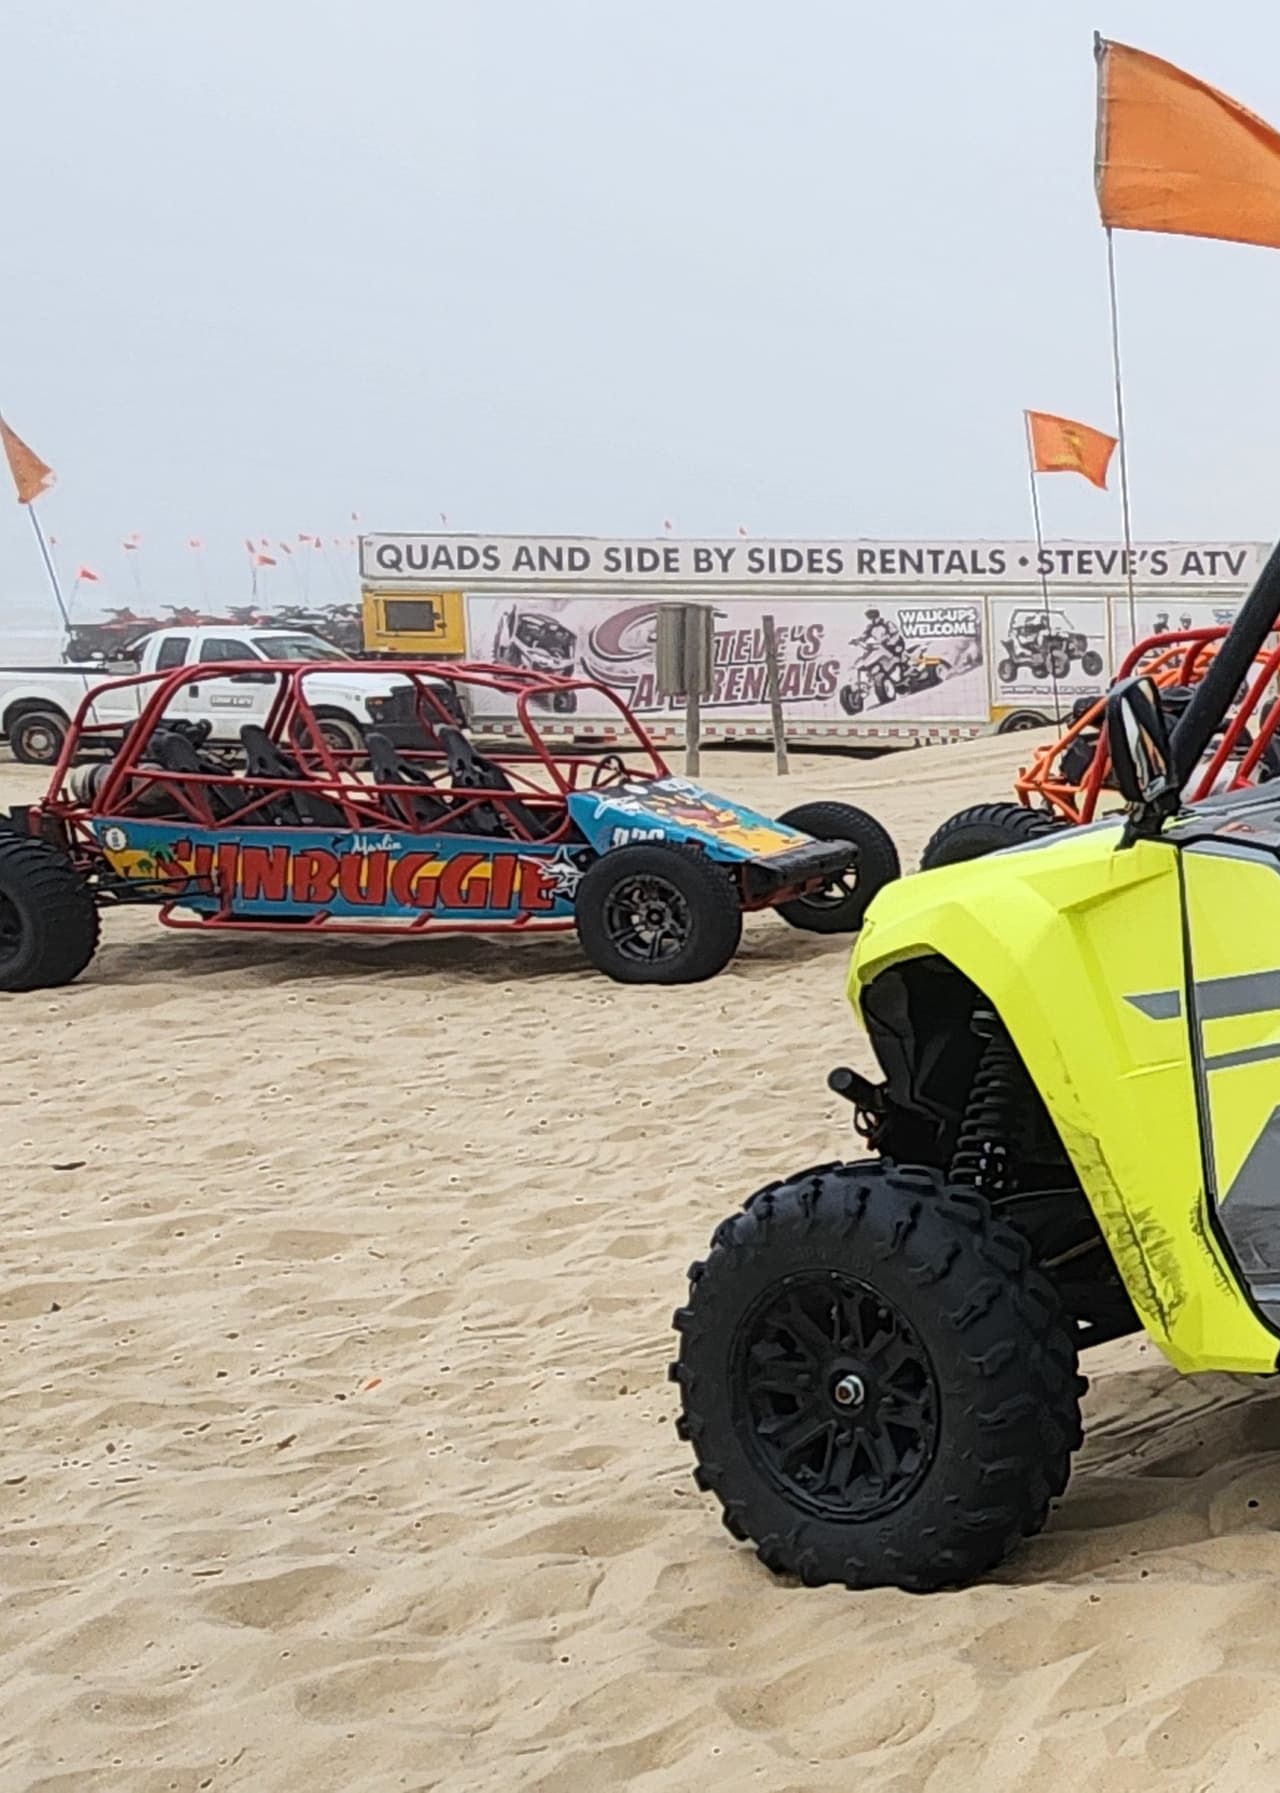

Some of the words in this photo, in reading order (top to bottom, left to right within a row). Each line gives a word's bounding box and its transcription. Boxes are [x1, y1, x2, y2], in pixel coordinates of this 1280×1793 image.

[376, 544, 500, 572] QUADS
[512, 545, 591, 573] AND
[603, 546, 680, 574] SIDE
[693, 547, 737, 574] BY
[747, 547, 844, 575] SIDES
[857, 549, 1007, 575] RENTALS
[1036, 549, 1169, 576] STEVE'S
[1180, 550, 1248, 577] ATV
[902, 621, 977, 637] WELCOME
